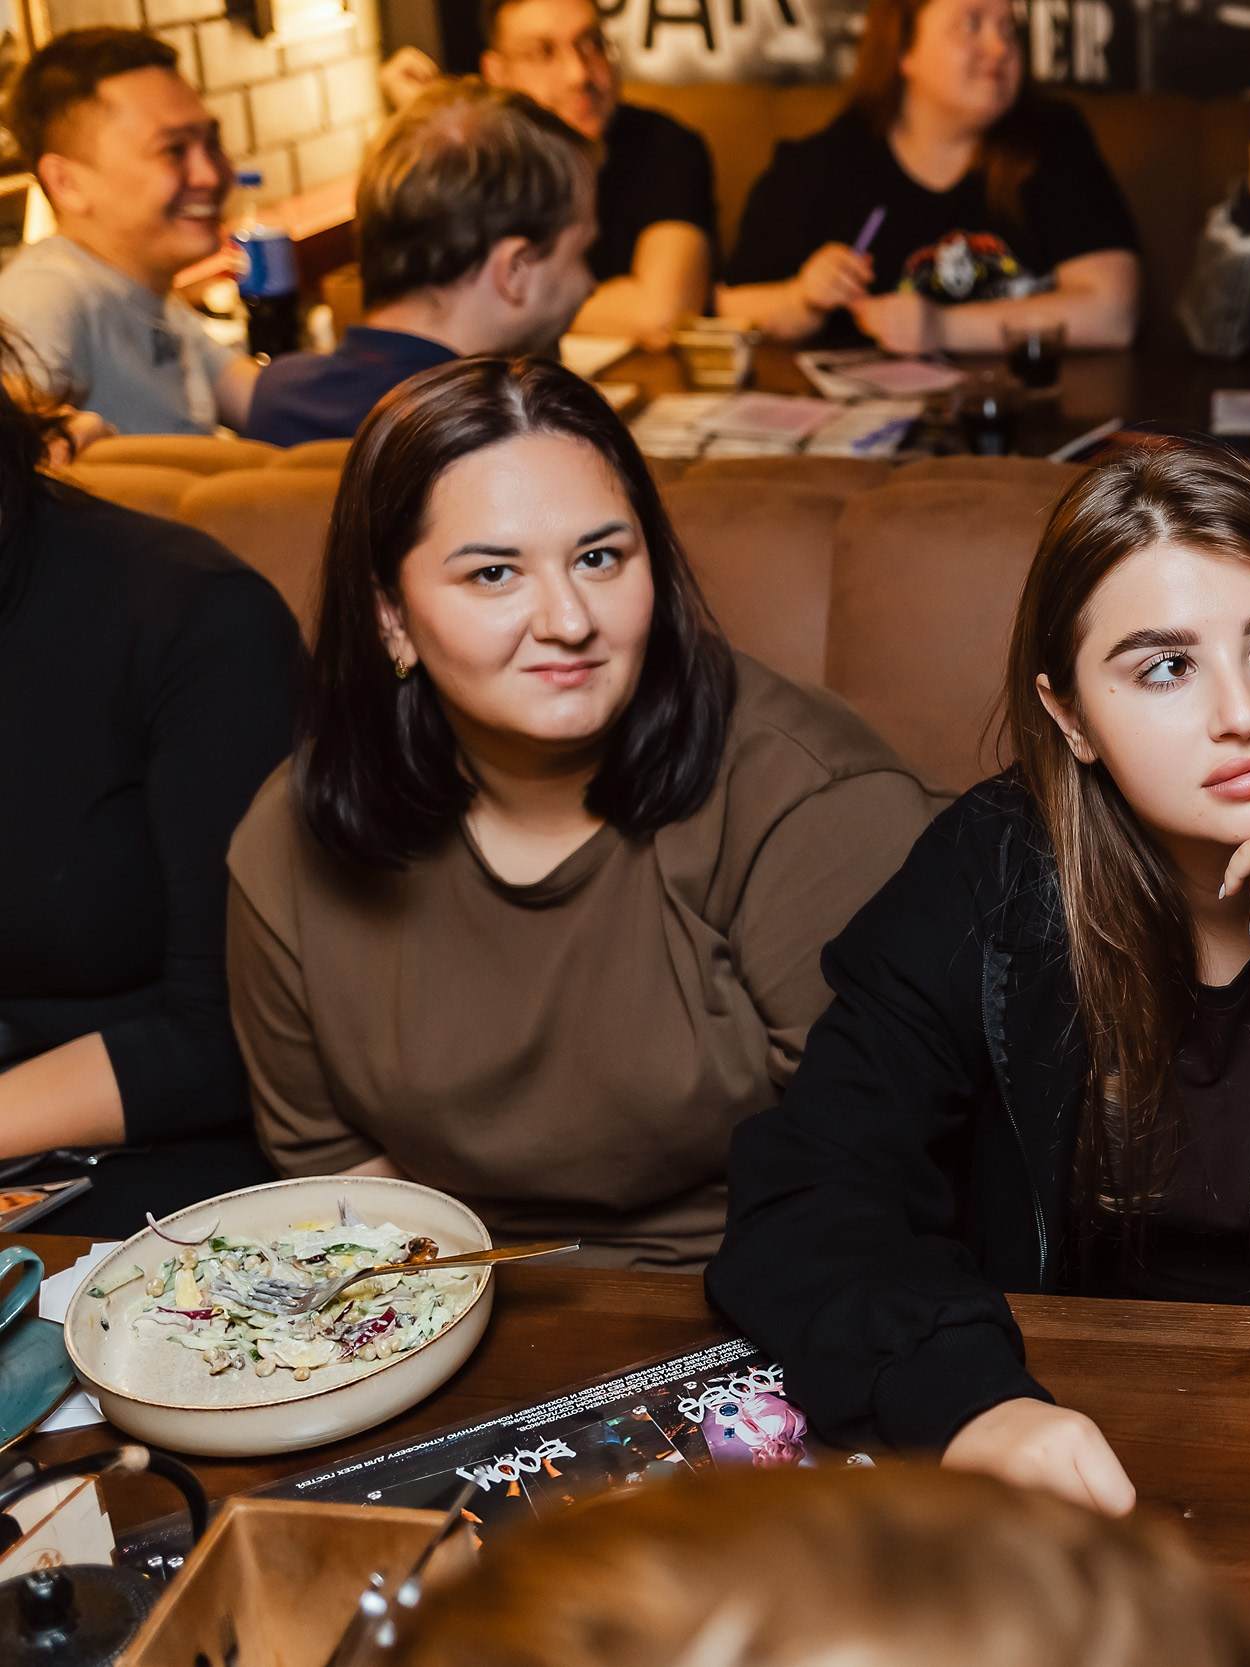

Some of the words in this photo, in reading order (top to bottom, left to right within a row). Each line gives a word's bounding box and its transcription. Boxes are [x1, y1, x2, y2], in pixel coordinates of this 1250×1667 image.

[1014, 0, 1115, 82] ER
[666, 1350, 703, 1367] ЛИЧНЫЕ
[682, 1351, 717, 1367] ВПРАВЕ
[682, 1355, 718, 1372] ТОЛЬКО
[623, 1362, 666, 1381] ГРАНИЦЫ
[625, 1362, 682, 1386] ОТКАЗАТЬСЯ
[642, 1368, 696, 1391] СВЯЗАННЫЕ
[649, 1374, 664, 1383] ИХ
[663, 1367, 682, 1378] ПРИ
[569, 1391, 577, 1399] И
[574, 1379, 648, 1408] ДОБРОВОЛЬНОМ
[577, 1376, 623, 1396] КОМАНДЫ
[606, 1381, 625, 1392] БЕЗ
[513, 1394, 569, 1418] СОХРАНЯЕМ
[546, 1388, 606, 1412] ОБЪЯСНЕНИЯ
[584, 1389, 634, 1410] УЧАСТИЕМ
[445, 1413, 513, 1440] КОМФОРТНУЮ
[515, 1405, 584, 1433] СОТРУДНИКОВ,
[386, 1435, 445, 1459] АТМОСФЕРУ
[335, 1462, 363, 1476] ВСЕХ
[362, 1455, 385, 1467] ДЛЯ
[456, 1437, 577, 1492] BOOM
[294, 1471, 336, 1489] ГОСТЕЙ.
